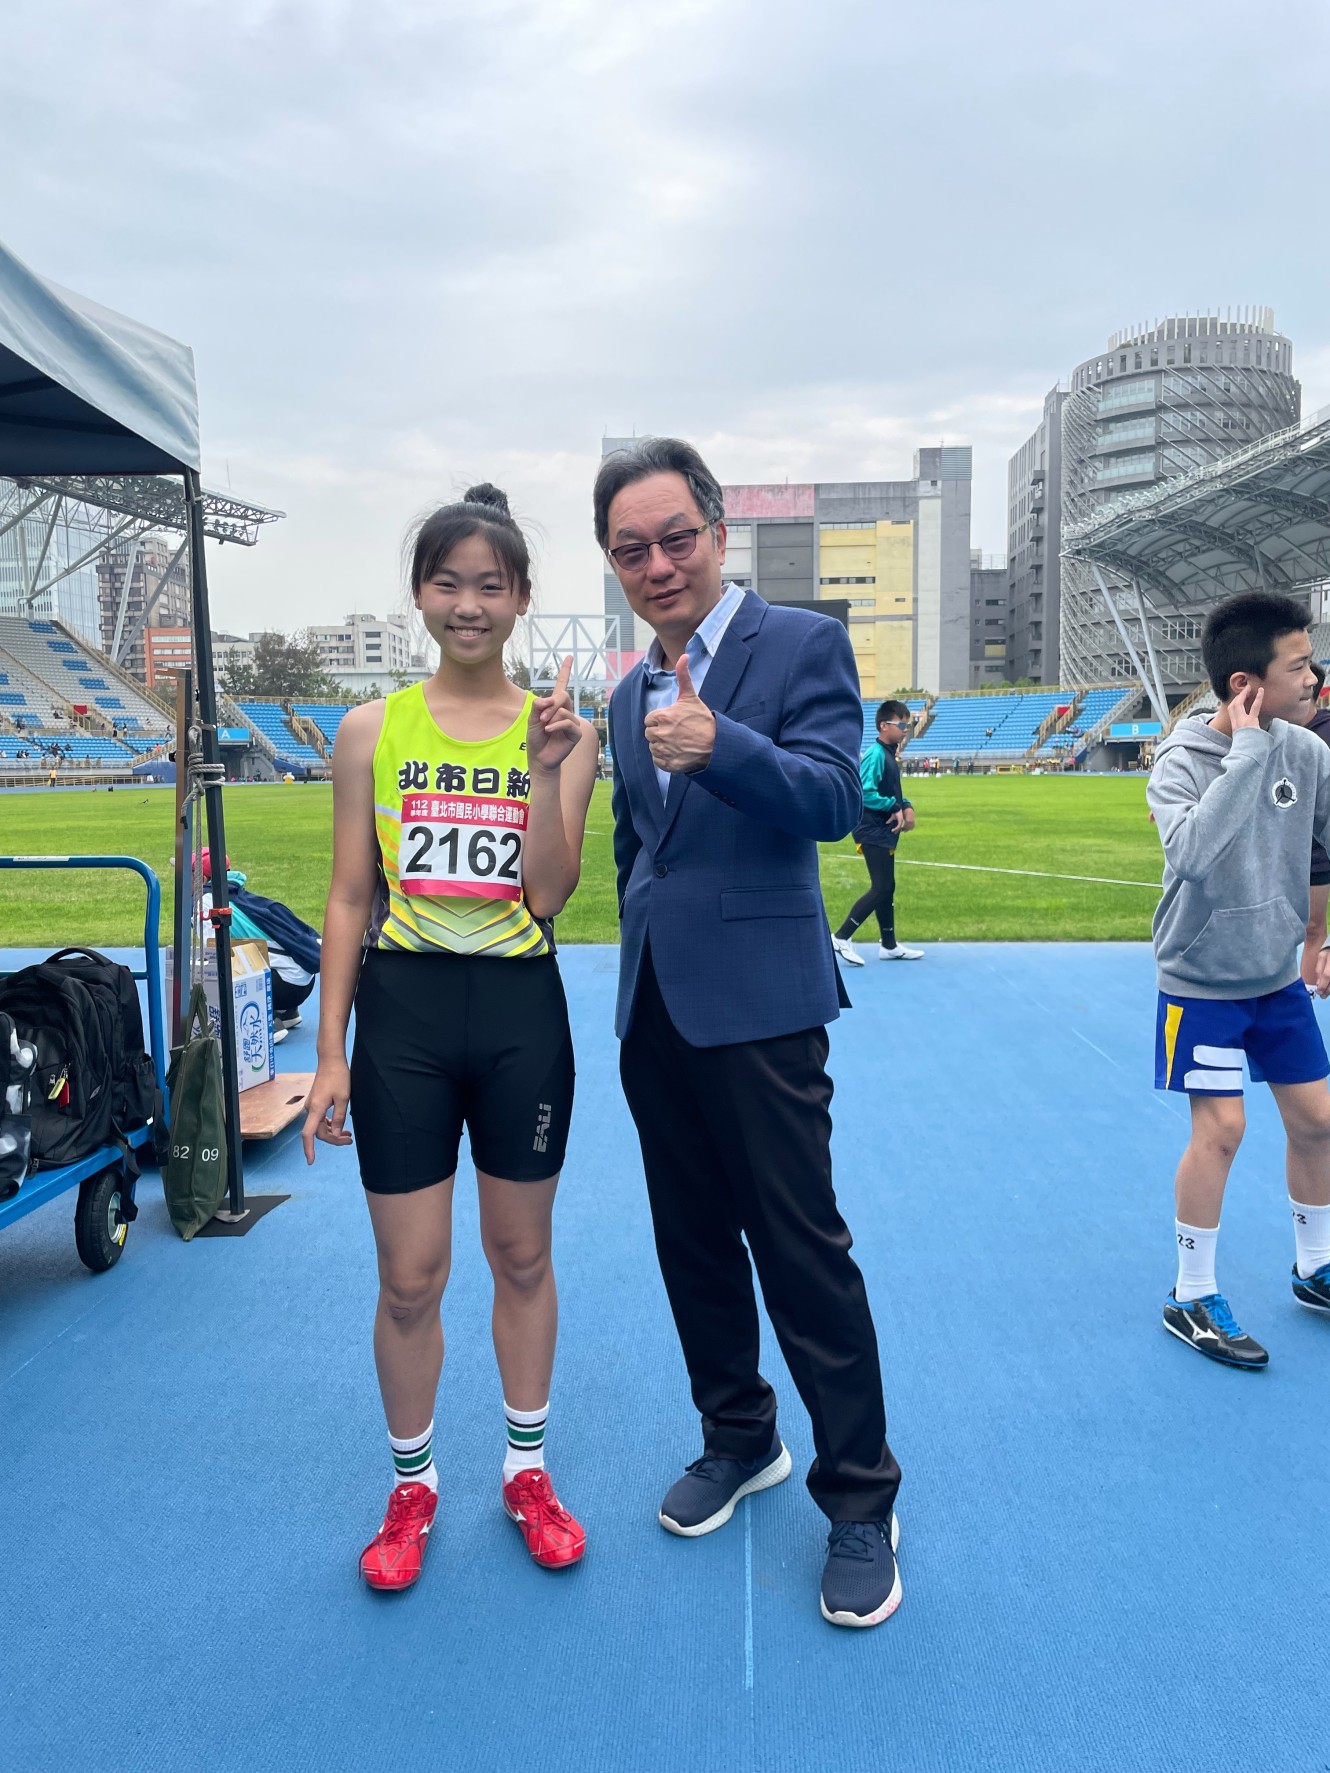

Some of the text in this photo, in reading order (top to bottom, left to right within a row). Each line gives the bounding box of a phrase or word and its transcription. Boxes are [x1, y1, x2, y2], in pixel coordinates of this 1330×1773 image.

[221, 729, 231, 739] A
[1132, 724, 1139, 735] B
[398, 760, 531, 799] 北市日新
[411, 800, 428, 809] 112
[430, 800, 525, 825] 臺北市國民小學聯合運動會
[405, 825, 522, 880] 2162
[250, 1014, 262, 1062] 天然水
[532, 1102, 552, 1153] EALI
[172, 1145, 219, 1162] 82 09
[1177, 1233, 1195, 1250] 23
